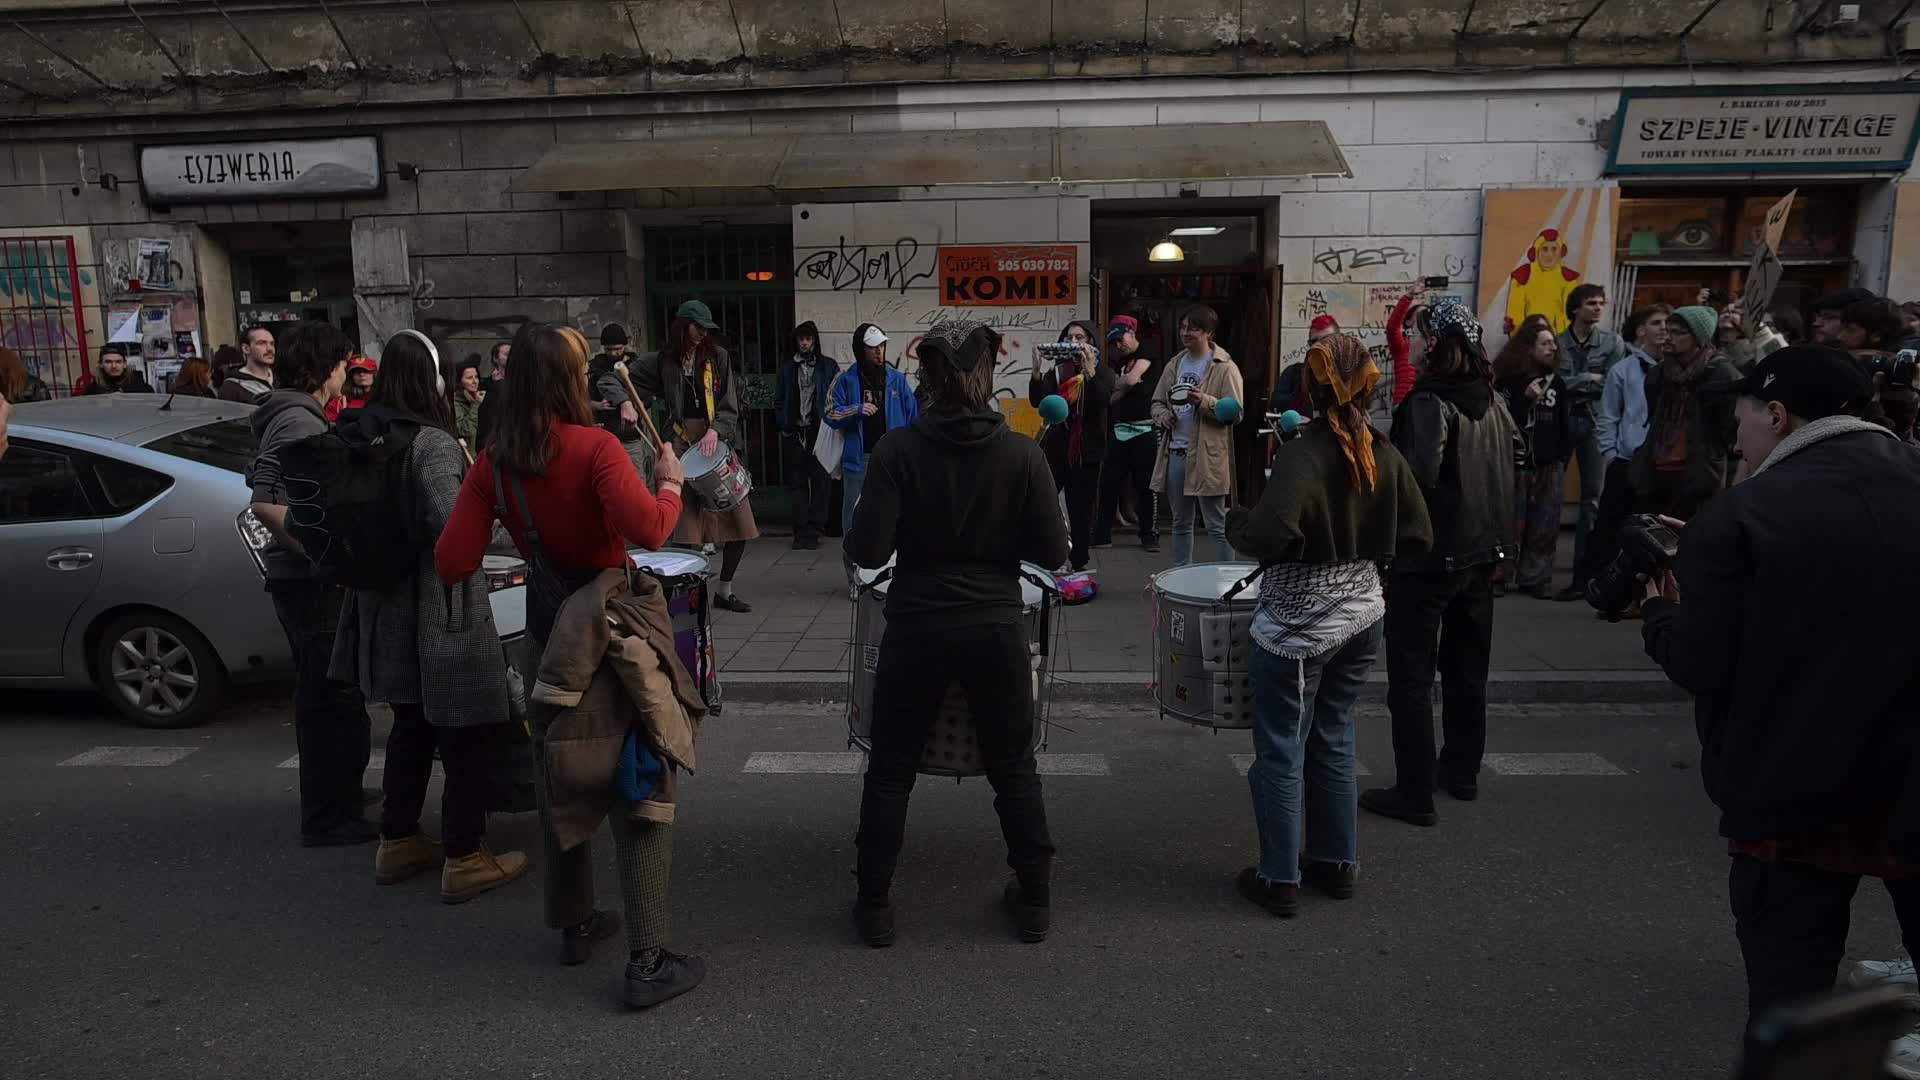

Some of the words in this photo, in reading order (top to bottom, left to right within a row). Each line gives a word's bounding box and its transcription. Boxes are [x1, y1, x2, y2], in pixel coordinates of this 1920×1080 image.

[1640, 117, 1748, 141] SZPEJE
[1765, 114, 1897, 139] VINTAGE
[1641, 149, 1686, 159] TOWARY
[1691, 148, 1738, 158] VINTAGE
[1744, 147, 1797, 157] PLAKATY
[997, 259, 1020, 272] 505
[1022, 259, 1045, 271] 030
[1047, 259, 1070, 271] 782
[946, 274, 1071, 300] KOMIS
